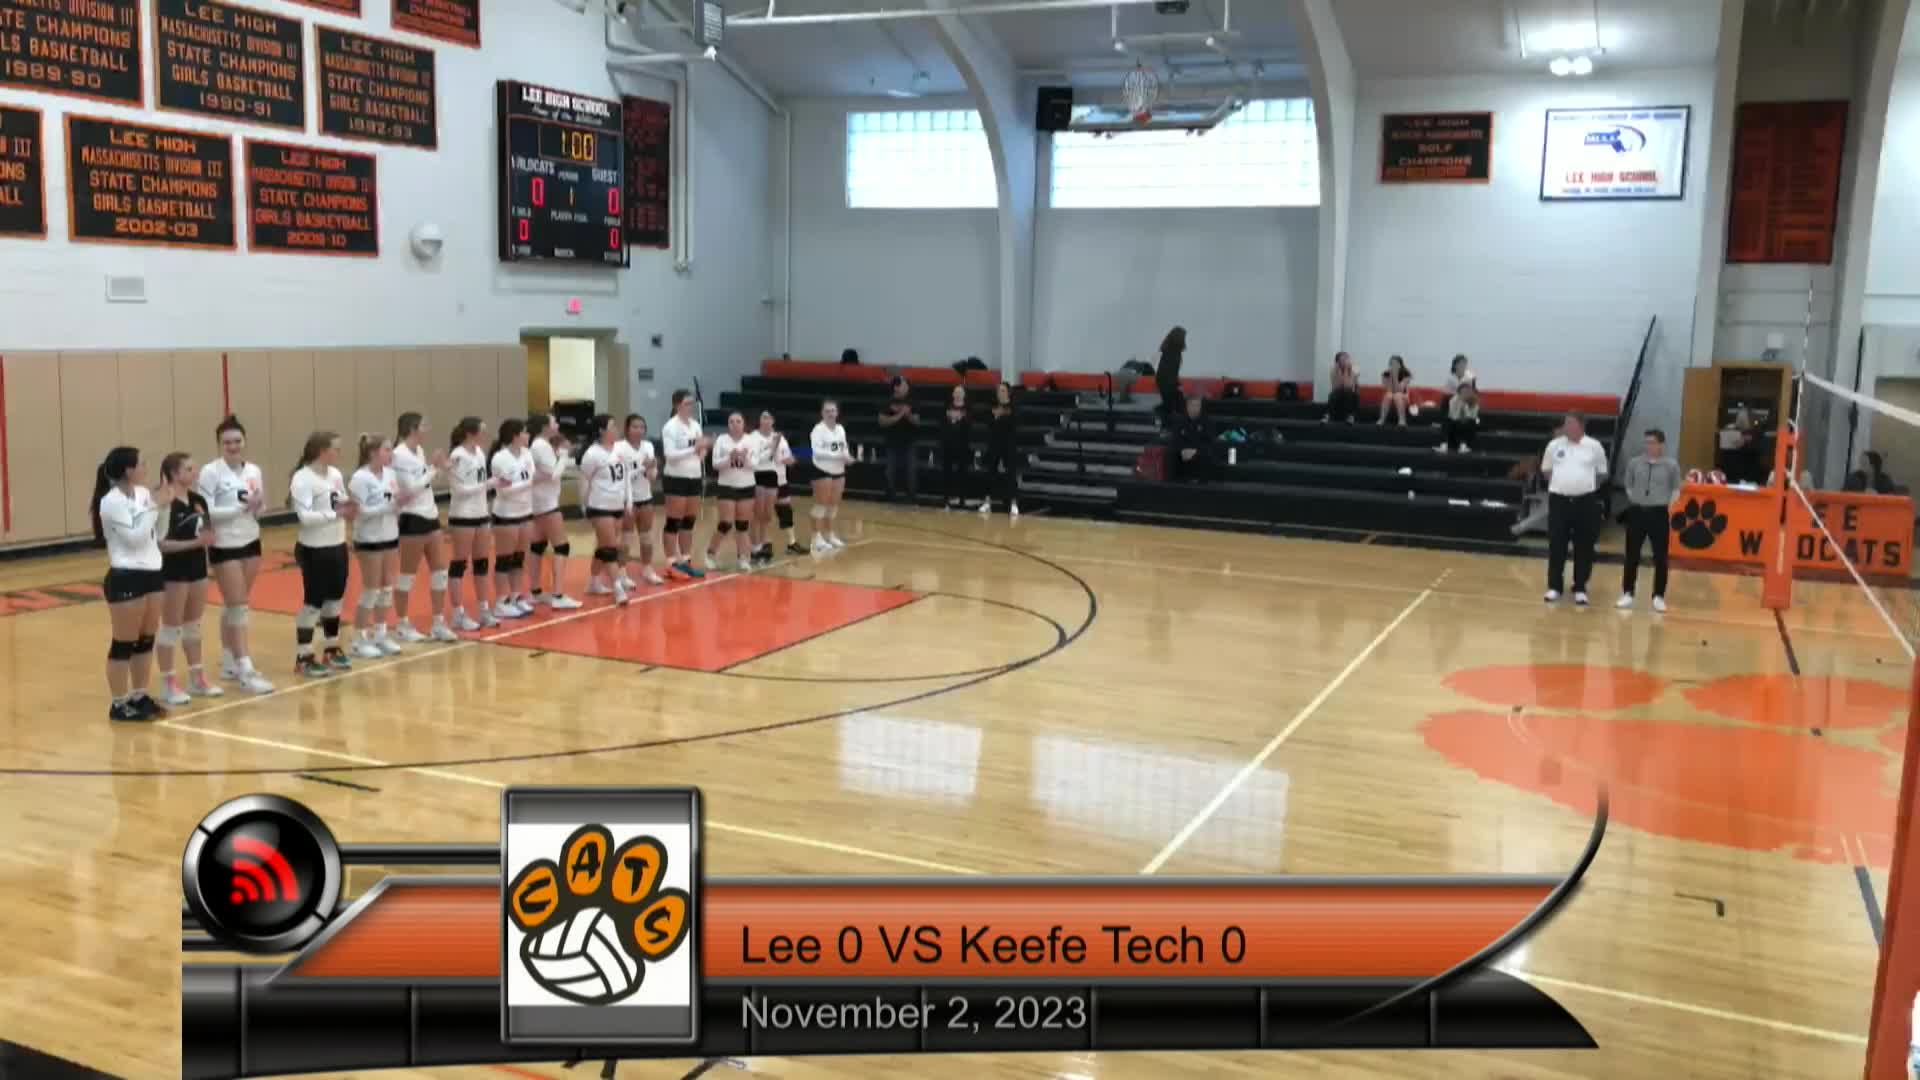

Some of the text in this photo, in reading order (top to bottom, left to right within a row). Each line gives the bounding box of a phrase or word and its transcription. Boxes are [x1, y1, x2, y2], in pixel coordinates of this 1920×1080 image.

[184, 0, 277, 34] LEE HIGH
[36, 15, 131, 48] CHAMPIONS
[30, 37, 128, 71] BASKETBALL
[167, 40, 296, 80] STATE CHAMPIONS
[172, 63, 293, 101] GIRLS BASKETBALL
[327, 73, 429, 105] STATE CHAMPIONS
[366, 99, 429, 124] BASKETBALL
[522, 86, 542, 104] LEE
[544, 91, 570, 109] HIGH
[572, 97, 610, 117] SCHOOL
[109, 127, 197, 154] LEE HIGH
[81, 145, 160, 172] MASSACHUSETTS
[89, 169, 218, 199] STATE CHAMPIONS
[592, 167, 617, 184] GUEST
[93, 192, 216, 219] GIRLS BASKETBALL
[259, 188, 368, 212] STATE CHAMPIONS
[531, 177, 545, 207] 0
[607, 187, 620, 216] 0
[115, 217, 199, 237] 2002-03
[255, 208, 370, 231] GIRLS BASKETBALL
[519, 218, 530, 241] 0
[609, 227, 619, 249] 0
[608, 463, 625, 484] 13
[1738, 530, 1902, 567] WDCATS
